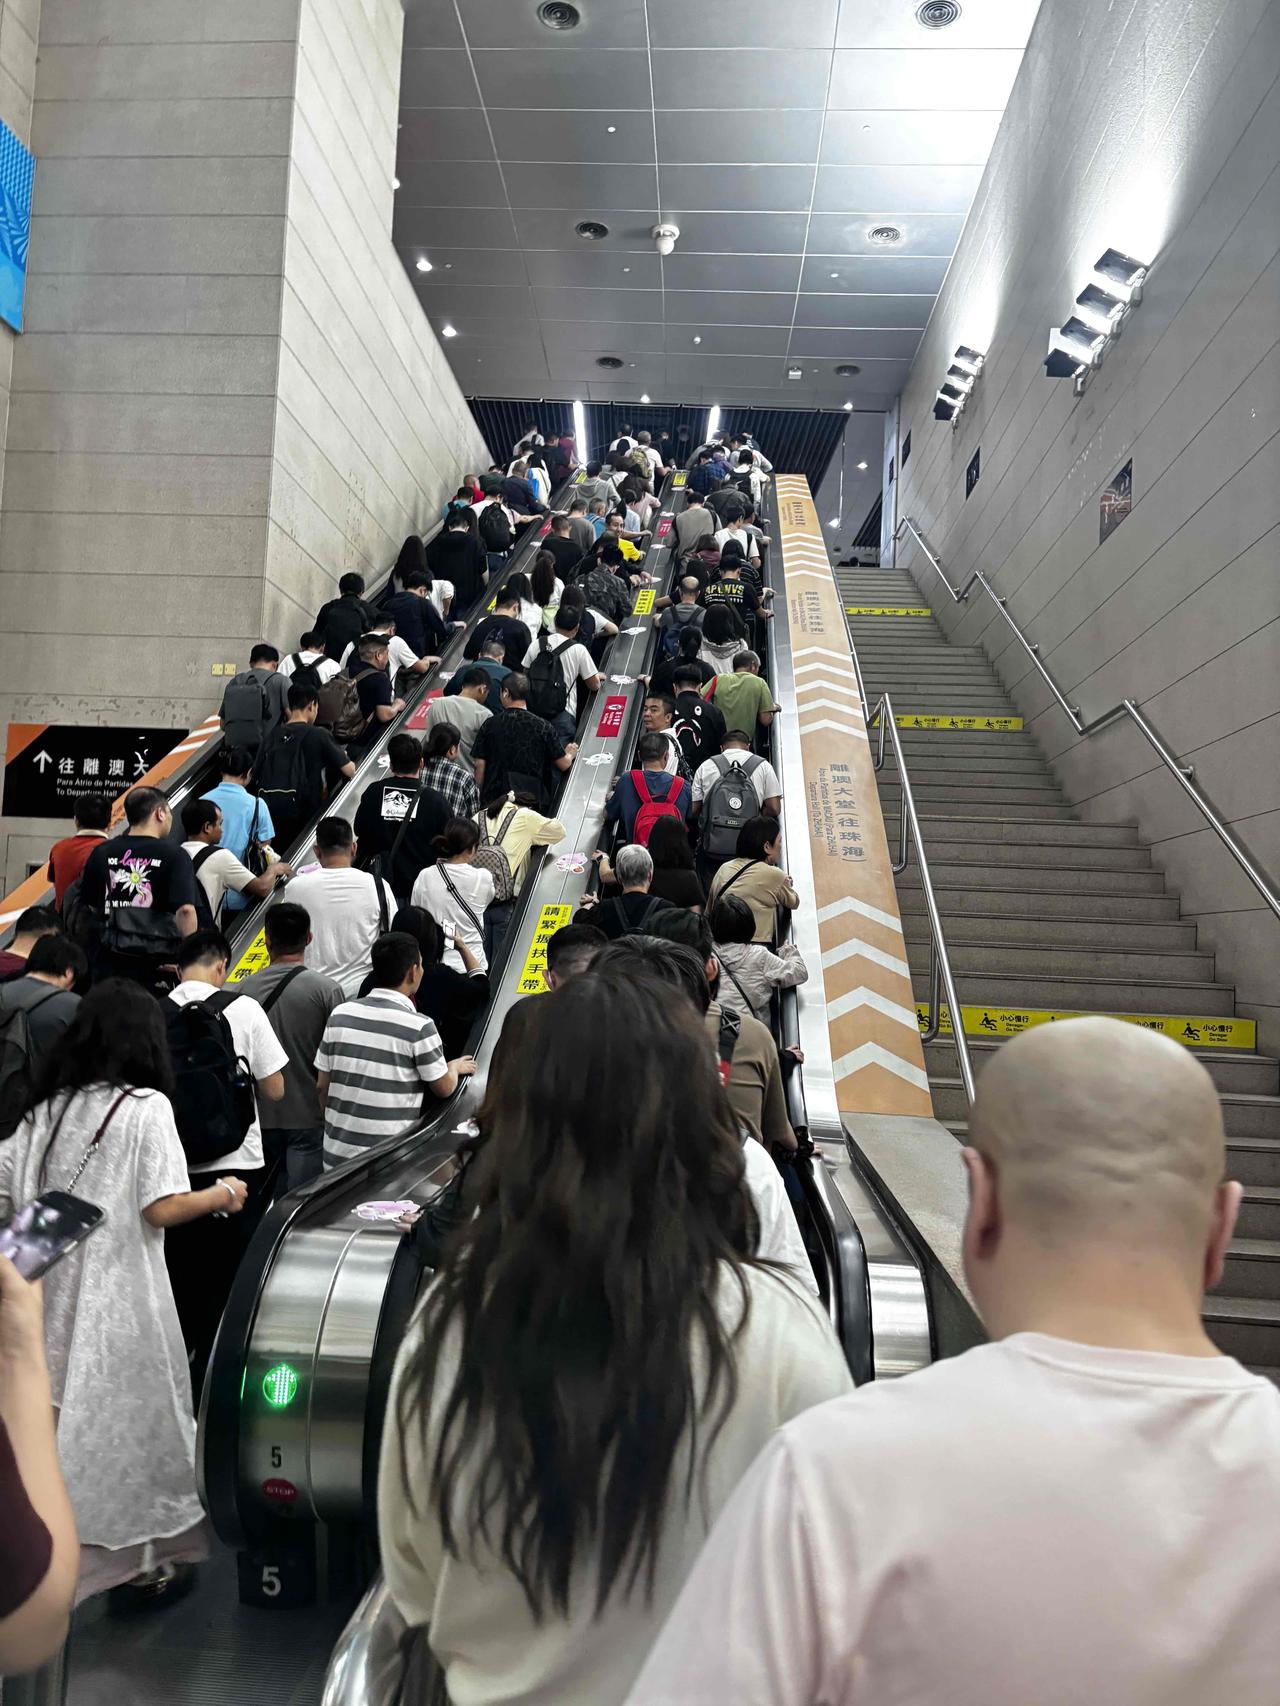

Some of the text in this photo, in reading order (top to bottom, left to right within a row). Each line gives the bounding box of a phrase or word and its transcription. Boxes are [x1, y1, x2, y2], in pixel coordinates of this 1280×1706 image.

[57, 777, 73, 786] Para
[74, 777, 93, 787] Átrio
[94, 779, 103, 787] de
[57, 787, 65, 795] To
[271, 1446, 282, 1469] 5
[265, 1485, 295, 1496] STOP
[262, 1565, 282, 1597] 5
